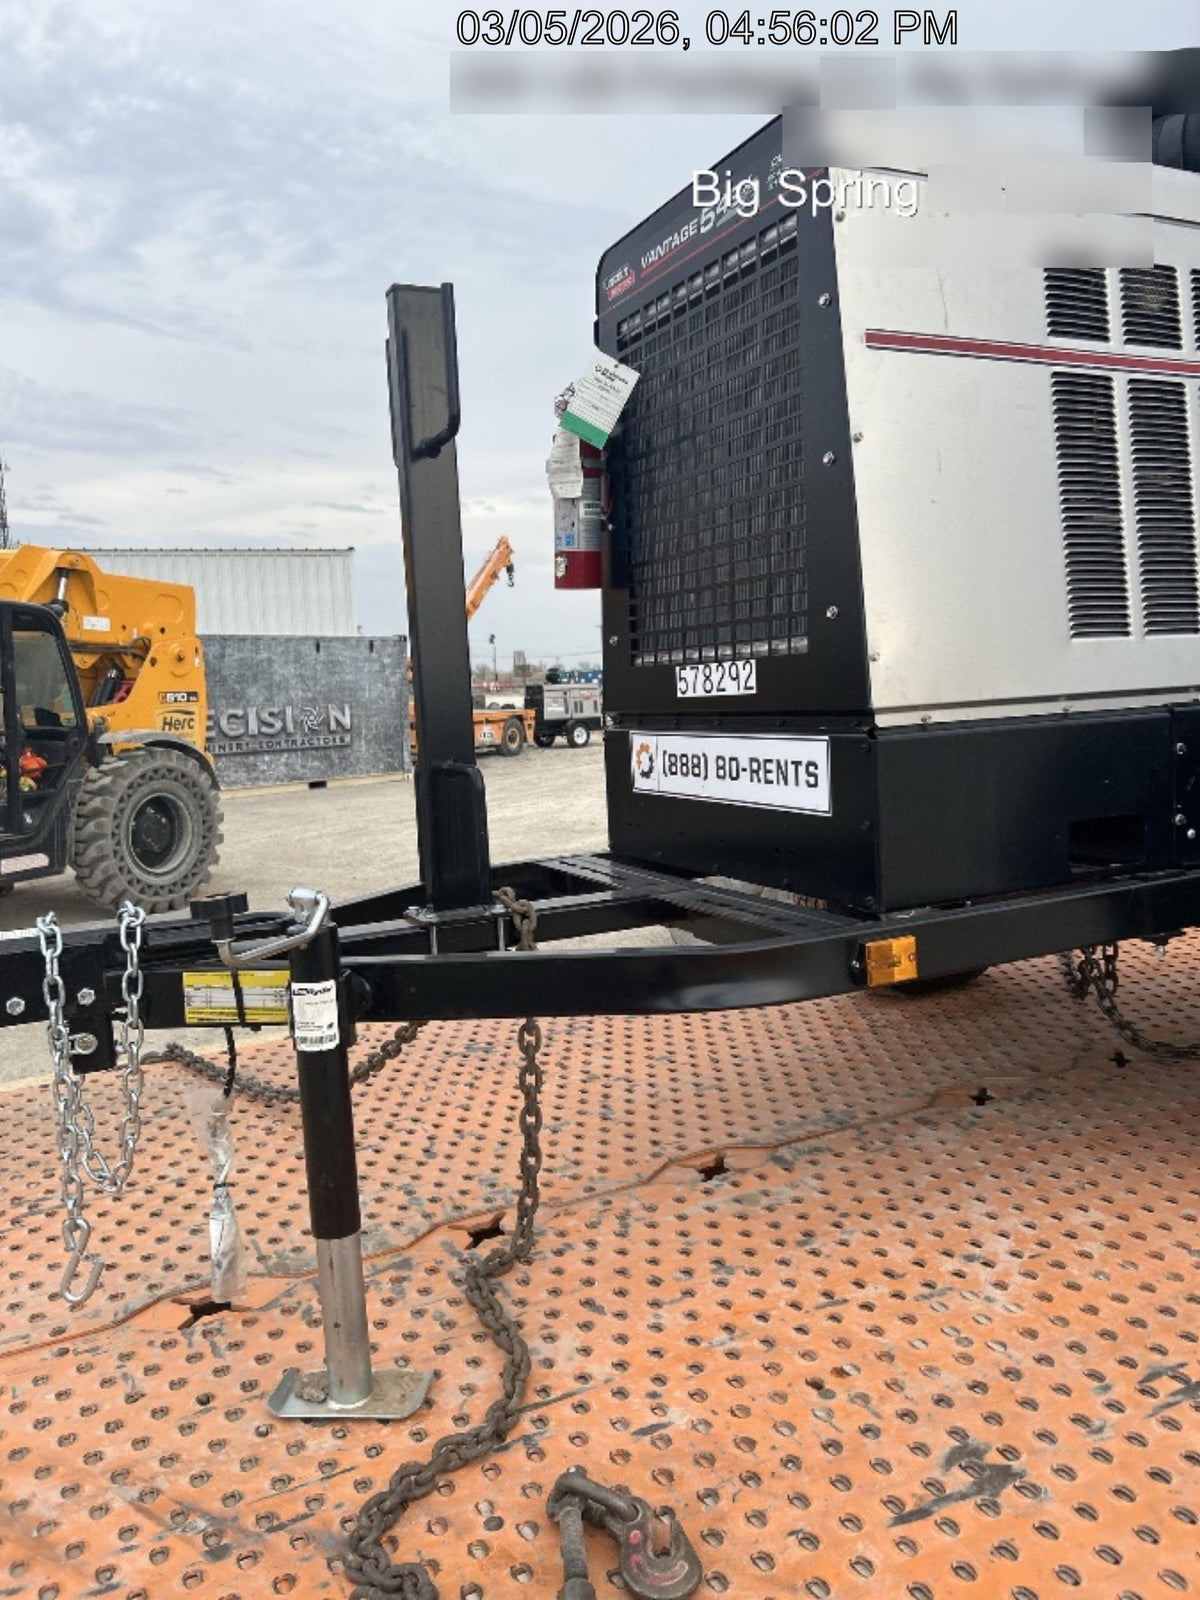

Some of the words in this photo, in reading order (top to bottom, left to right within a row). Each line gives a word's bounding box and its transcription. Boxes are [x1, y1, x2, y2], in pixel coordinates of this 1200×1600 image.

[640, 218, 699, 269] VANTAGE
[678, 660, 755, 695] 578292
[161, 716, 195, 731] Herc
[259, 735, 346, 750] CONTRACTORS
[662, 749, 709, 781] (888)
